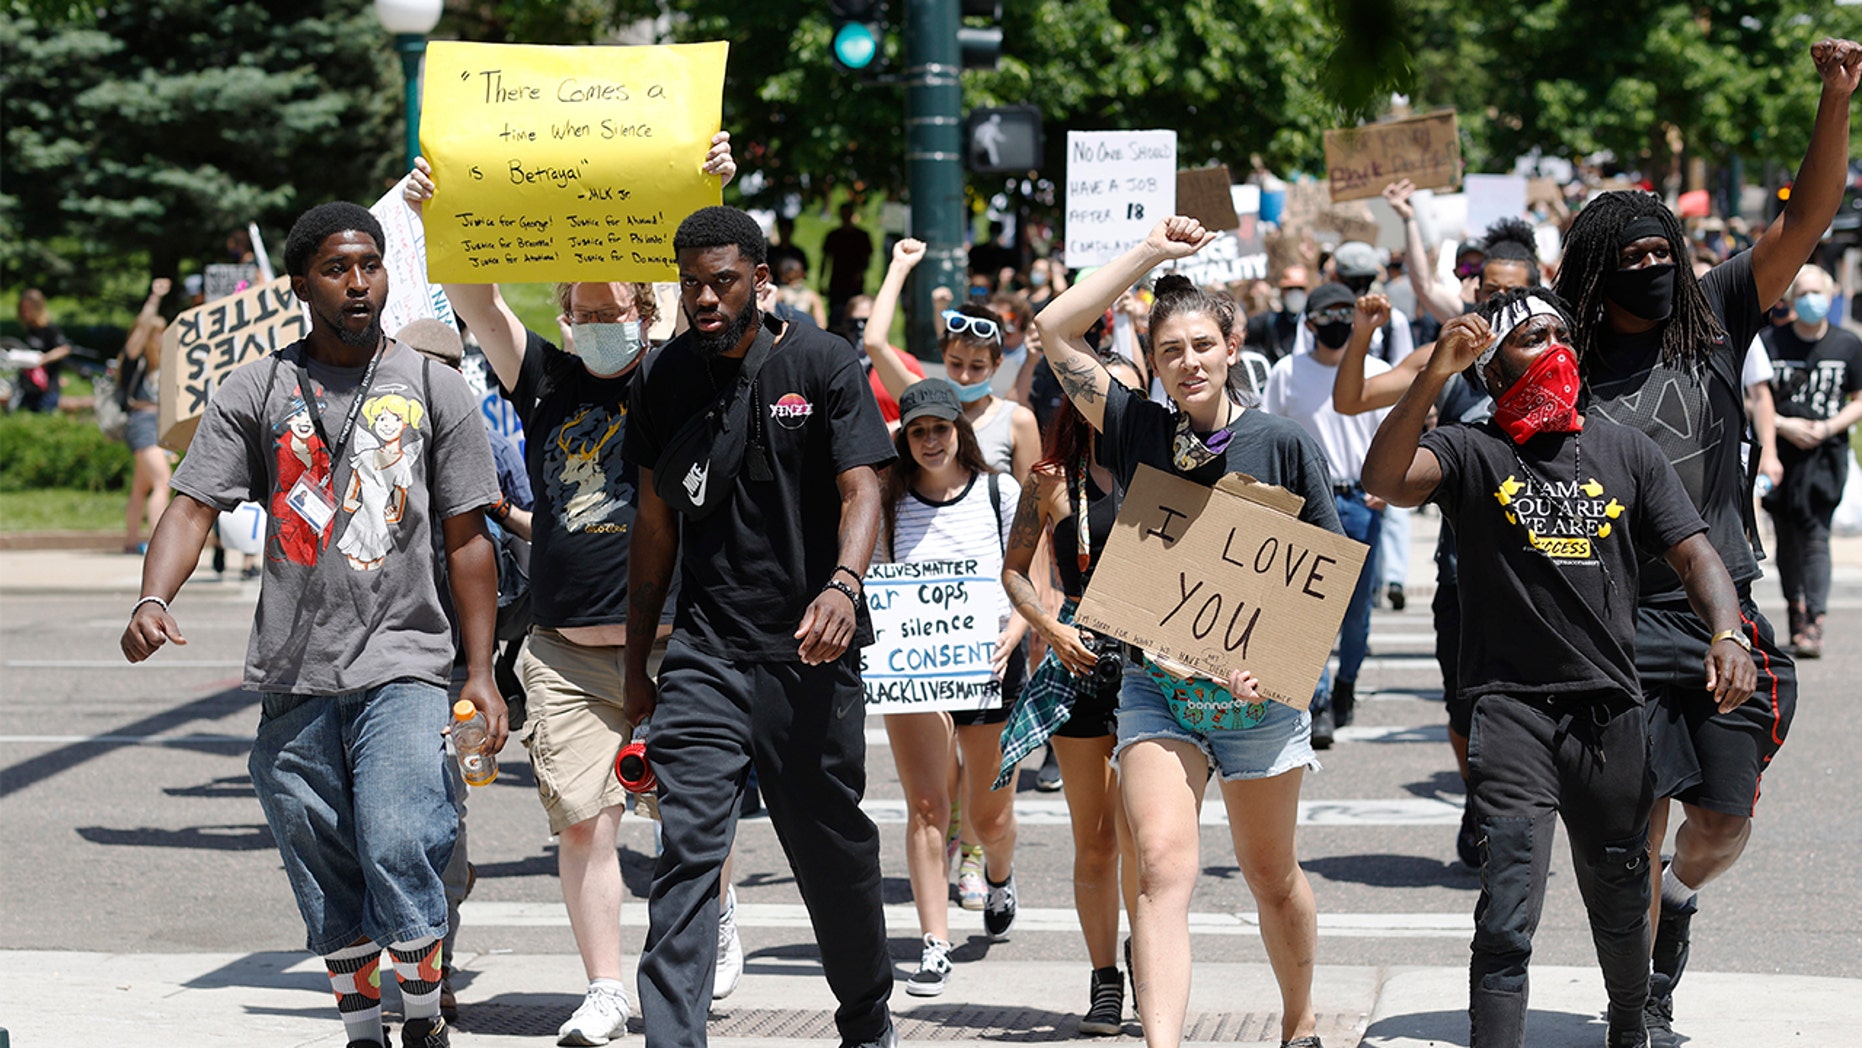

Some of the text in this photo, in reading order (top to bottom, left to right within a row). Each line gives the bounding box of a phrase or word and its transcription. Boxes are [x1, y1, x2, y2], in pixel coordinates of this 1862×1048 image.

[557, 78, 629, 103] Comes
[647, 84, 666, 99] a
[500, 122, 537, 141] time
[468, 165, 484, 180] is
[1070, 177, 1158, 196] HAVE A JOB
[454, 213, 495, 228] Justice
[499, 216, 515, 227] for
[566, 215, 599, 228] Justice
[605, 215, 621, 227] for
[1069, 203, 1144, 223] AFTER 18
[462, 239, 495, 253] Justice
[499, 237, 513, 249] for
[568, 236, 603, 249] Justice
[608, 233, 622, 244] for
[469, 256, 499, 268] Justice
[504, 252, 518, 264] for
[574, 252, 605, 263] Justice
[610, 250, 624, 262] for
[178, 286, 304, 347] ATTER
[186, 314, 305, 381] LIVES
[682, 462, 706, 495] NIKE
[1525, 478, 1578, 498] I AM
[1512, 498, 1606, 518] OU ARE
[1551, 519, 1599, 537] ARE
[1146, 505, 1337, 600] I LOVE
[1533, 540, 1588, 554] CCESS
[866, 588, 899, 610] ar
[1159, 572, 1261, 660] YOU
[901, 615, 974, 638] silence
[888, 642, 996, 672] CONSENT
[1113, 627, 1129, 639] FOR
[1177, 651, 1201, 667] HAVE
